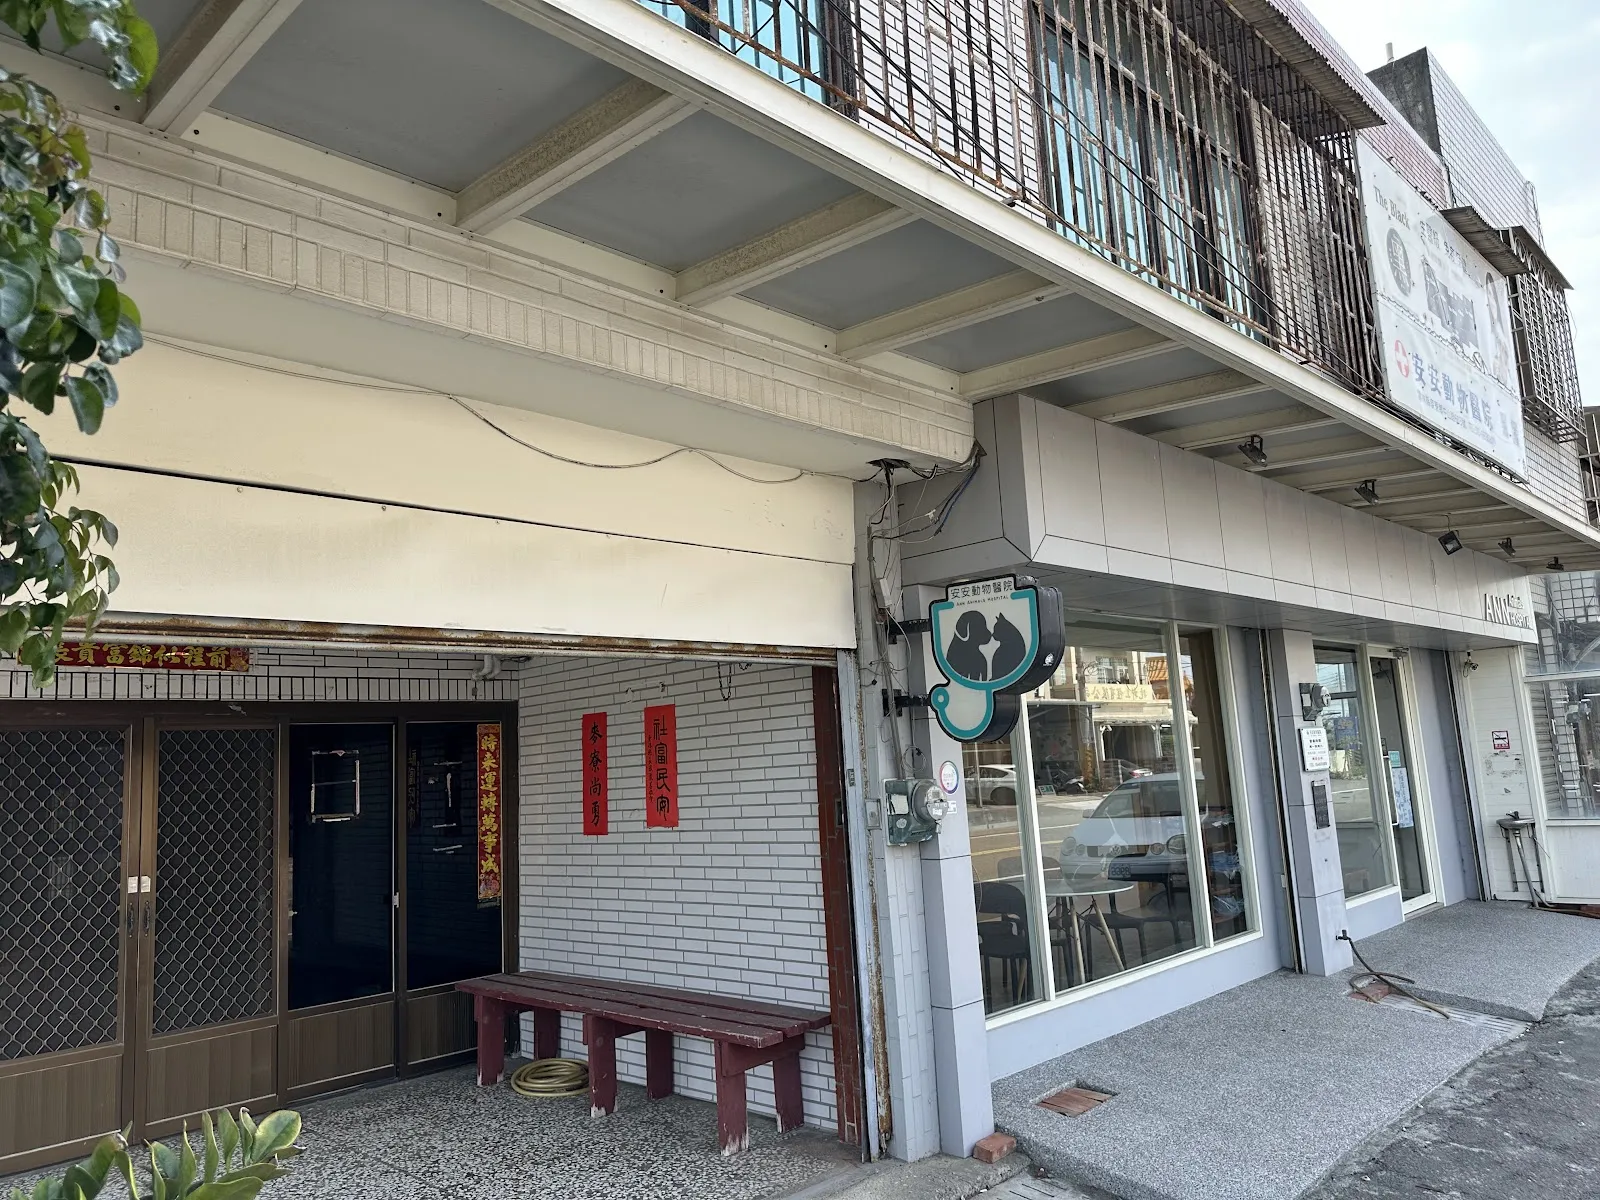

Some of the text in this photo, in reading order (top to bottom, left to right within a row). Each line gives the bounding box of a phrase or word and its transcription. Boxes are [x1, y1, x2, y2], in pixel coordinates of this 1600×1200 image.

[1373, 185, 1411, 230] The Black
[1411, 352, 1494, 432] 安安動物醫院
[950, 580, 1013, 600] 安安動物醫院
[1485, 593, 1511, 626] ANN
